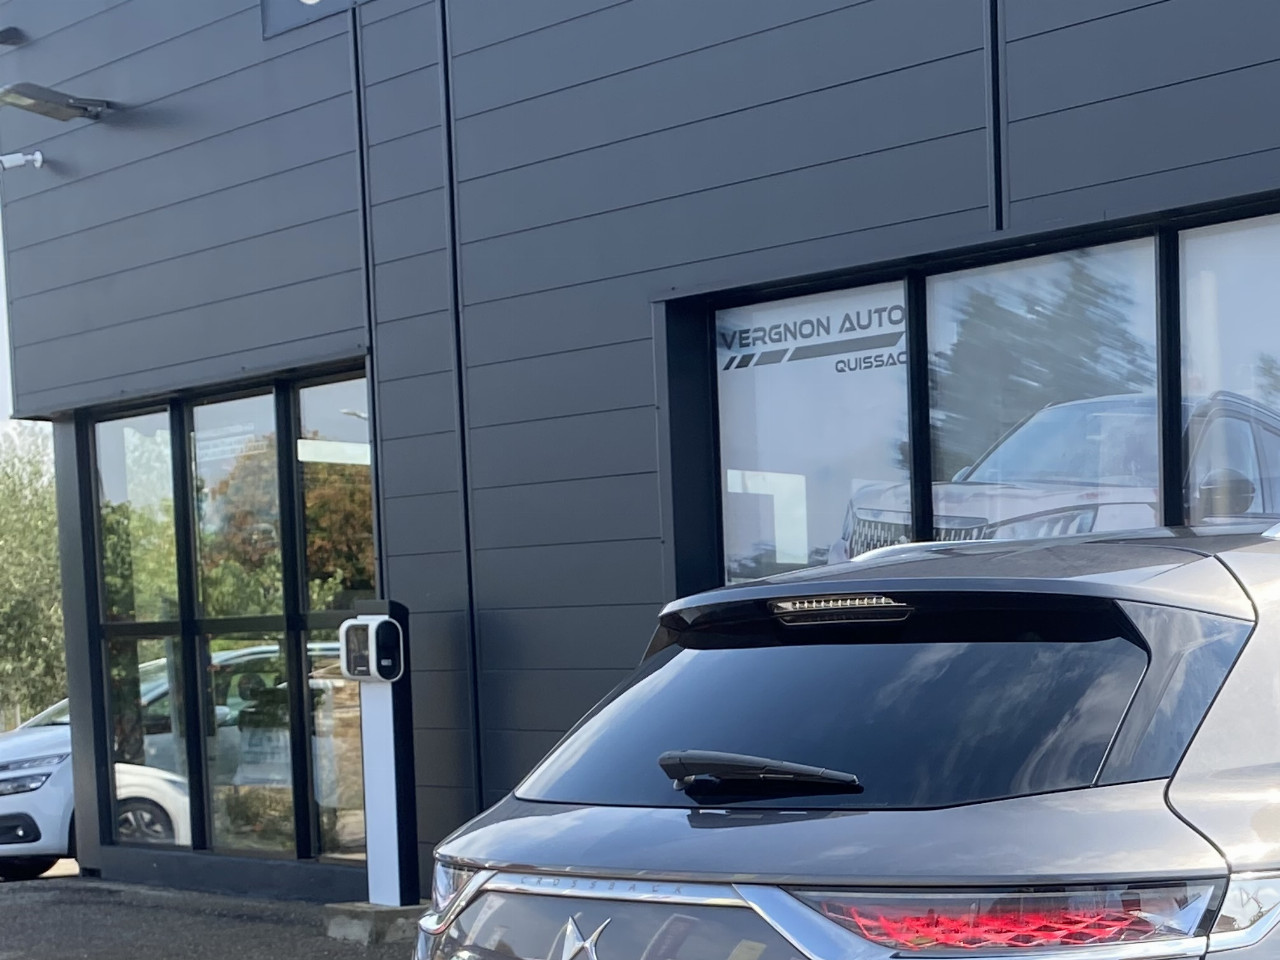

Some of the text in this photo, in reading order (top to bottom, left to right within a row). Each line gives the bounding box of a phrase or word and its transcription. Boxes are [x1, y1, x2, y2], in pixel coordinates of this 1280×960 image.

[721, 304, 906, 350] VERGNON AUTO
[520, 876, 682, 895] CROSSBACK
